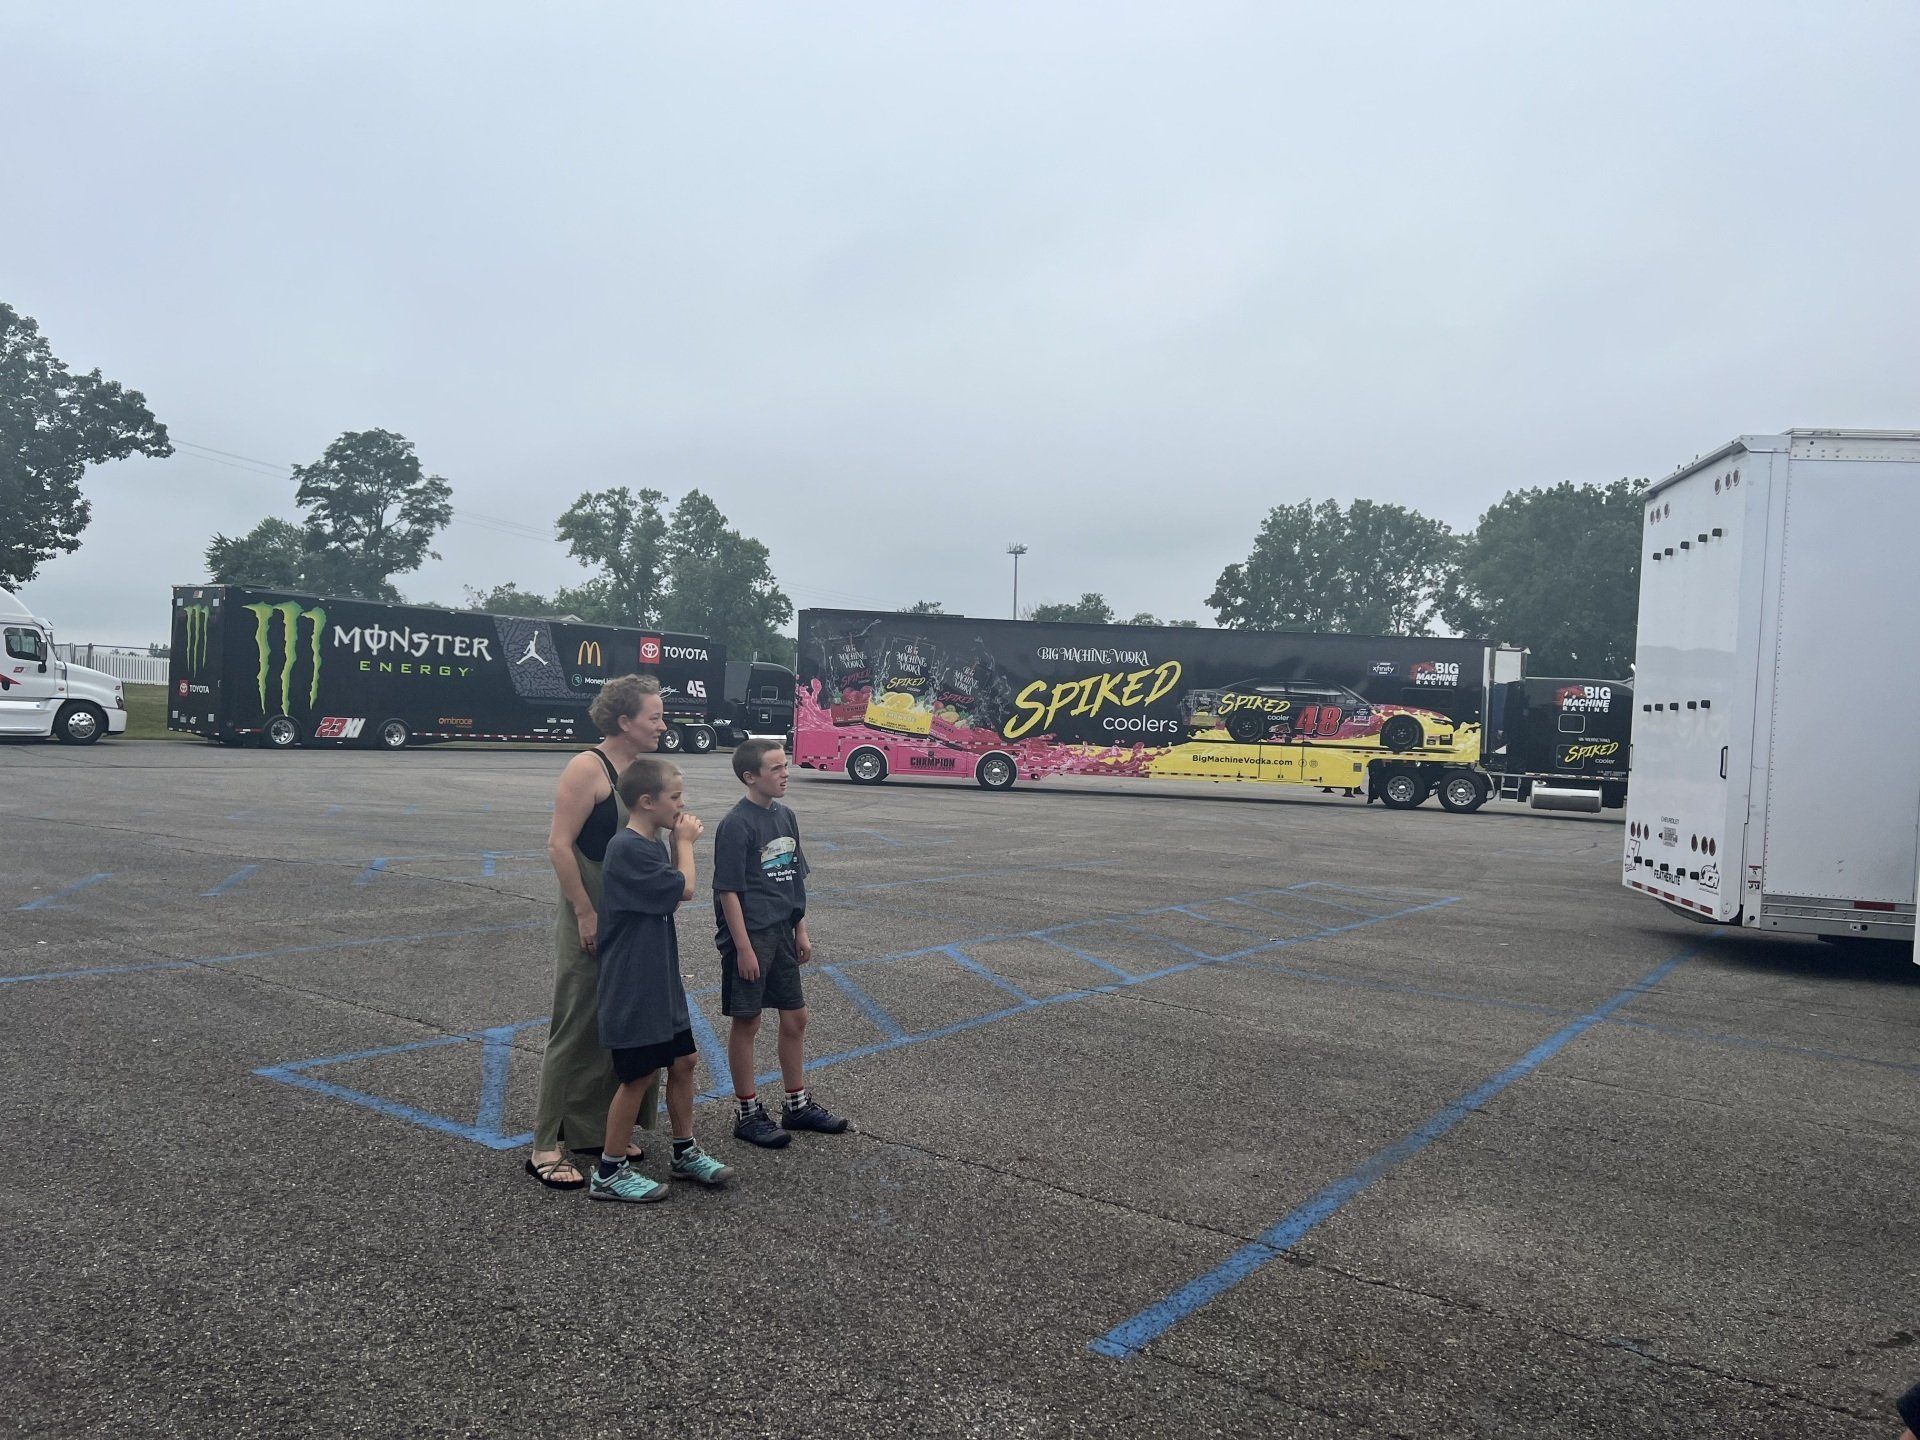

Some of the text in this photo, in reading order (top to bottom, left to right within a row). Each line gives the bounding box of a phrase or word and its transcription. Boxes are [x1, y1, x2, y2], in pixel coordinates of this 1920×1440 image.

[333, 624, 492, 661] MONSTER
[905, 644, 919, 654] BIG
[663, 646, 708, 661] TOYOTA
[896, 651, 927, 667] MACHINE
[1037, 647, 1150, 666] BIG MACHINE VODKA
[360, 661, 468, 676] ENERGY
[899, 662, 922, 676] VODKA
[1435, 662, 1459, 674] BIG
[886, 677, 926, 689] SPIKED
[1416, 673, 1458, 682] MACHINE
[189, 684, 210, 693] TOYOTA
[687, 680, 707, 698] 45
[1584, 686, 1611, 699] BIG
[938, 691, 975, 704] SPIKED
[1003, 661, 1182, 739] SPIKED
[1217, 691, 1290, 715] SPIKED
[1562, 698, 1610, 708] MACHINE
[1103, 714, 1178, 733] coolers
[1295, 705, 1342, 736] 48
[1564, 742, 1619, 763] SPIKED
[910, 756, 955, 768] CHAMPION
[1192, 754, 1293, 766] BigMachineVodka.com
[1660, 816, 1679, 824] CHEVROLET
[1654, 869, 1681, 886] FEATHERLITE
